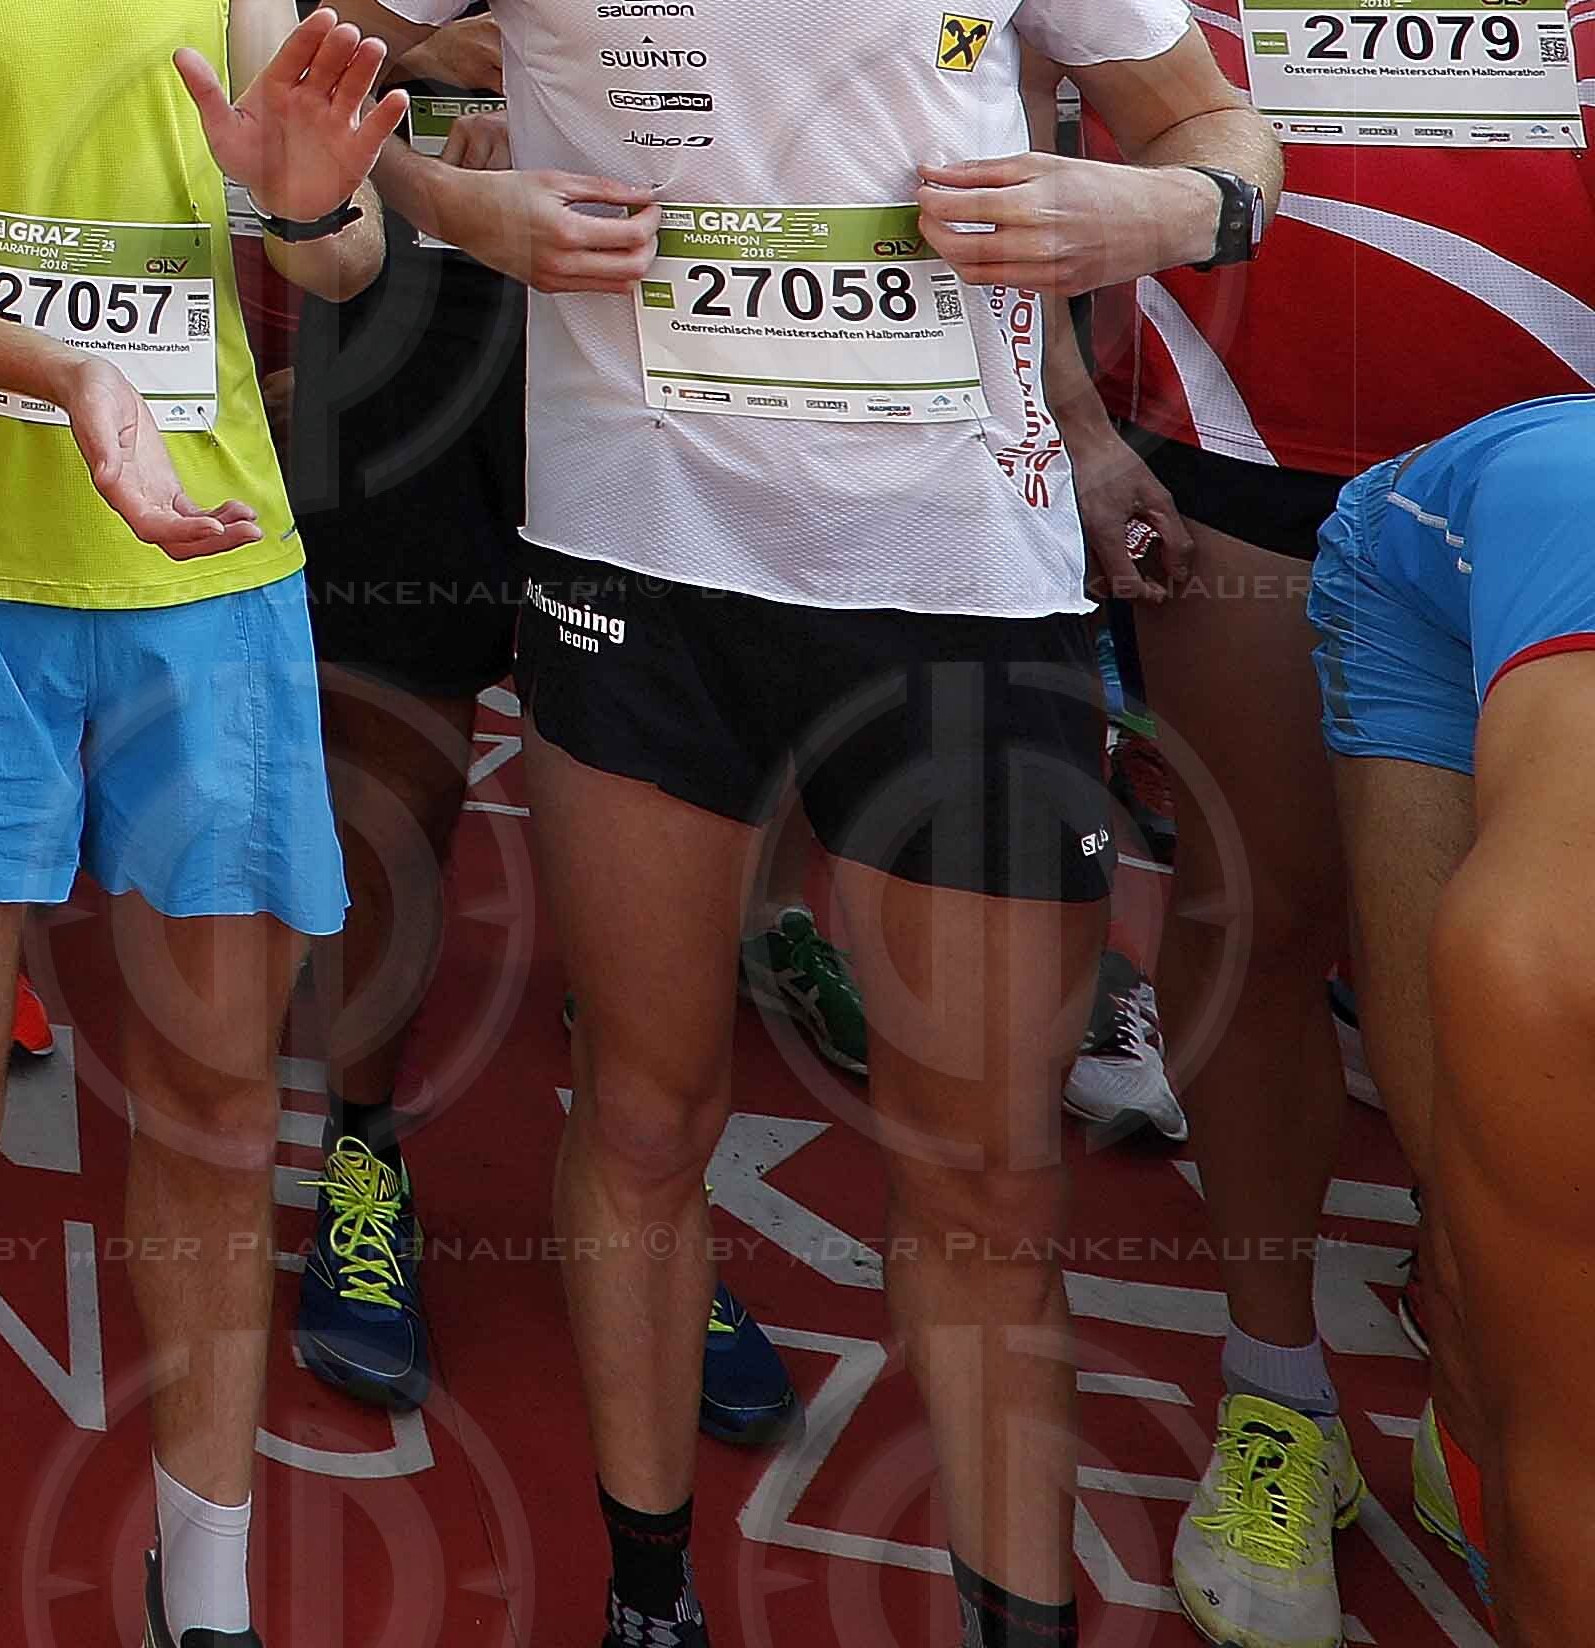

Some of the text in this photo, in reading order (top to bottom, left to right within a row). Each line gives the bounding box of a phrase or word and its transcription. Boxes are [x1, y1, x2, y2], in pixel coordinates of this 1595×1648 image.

[597, 3, 694, 19] salomon
[1304, 15, 1521, 62] 27079
[601, 50, 708, 69] SUUNTO
[1284, 65, 1546, 77] Österreichische Meisterschaften Halbmarathon
[699, 211, 784, 233] GRAZ
[812, 223, 829, 233] 25
[9, 222, 81, 246] GRAZ
[683, 234, 760, 245] MARATHON
[101, 240, 115, 251] 25
[740, 247, 774, 258] 2018
[40, 259, 68, 271] 2018
[687, 264, 918, 322] 27058
[671, 320, 944, 340] Österreichische Meisterschaften Halbmarathon
[129, 342, 190, 352] Halbmarathon
[559, 624, 599, 654] team
